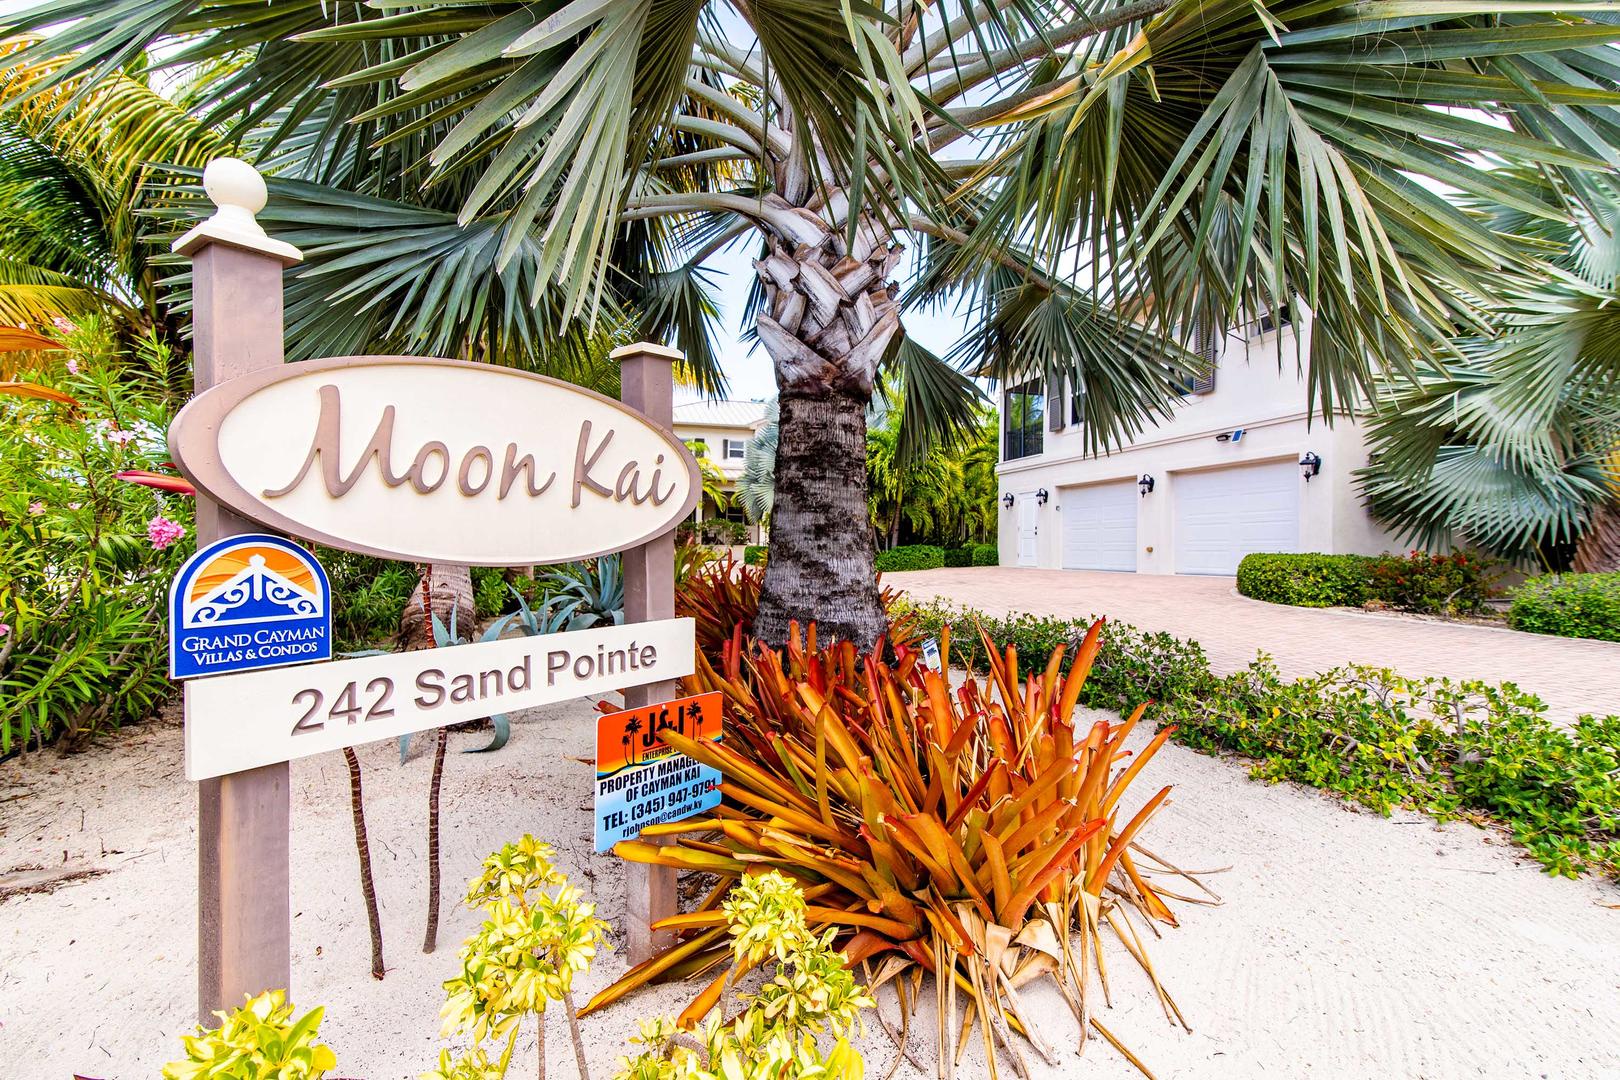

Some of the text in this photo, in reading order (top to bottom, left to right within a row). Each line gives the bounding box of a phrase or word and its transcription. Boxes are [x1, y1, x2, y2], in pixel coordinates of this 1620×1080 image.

[262, 384, 676, 508] Moon Kai
[182, 626, 325, 652] GRAND CAYMAN
[193, 642, 318, 666] VILLAS & CONDOS
[291, 641, 657, 737] 242 Sand Pointe
[600, 756, 700, 796] PROPERTY MANAGE
[626, 766, 700, 803] OF CAYMAN KAI
[603, 778, 716, 831] TEL: (345) 947-9791
